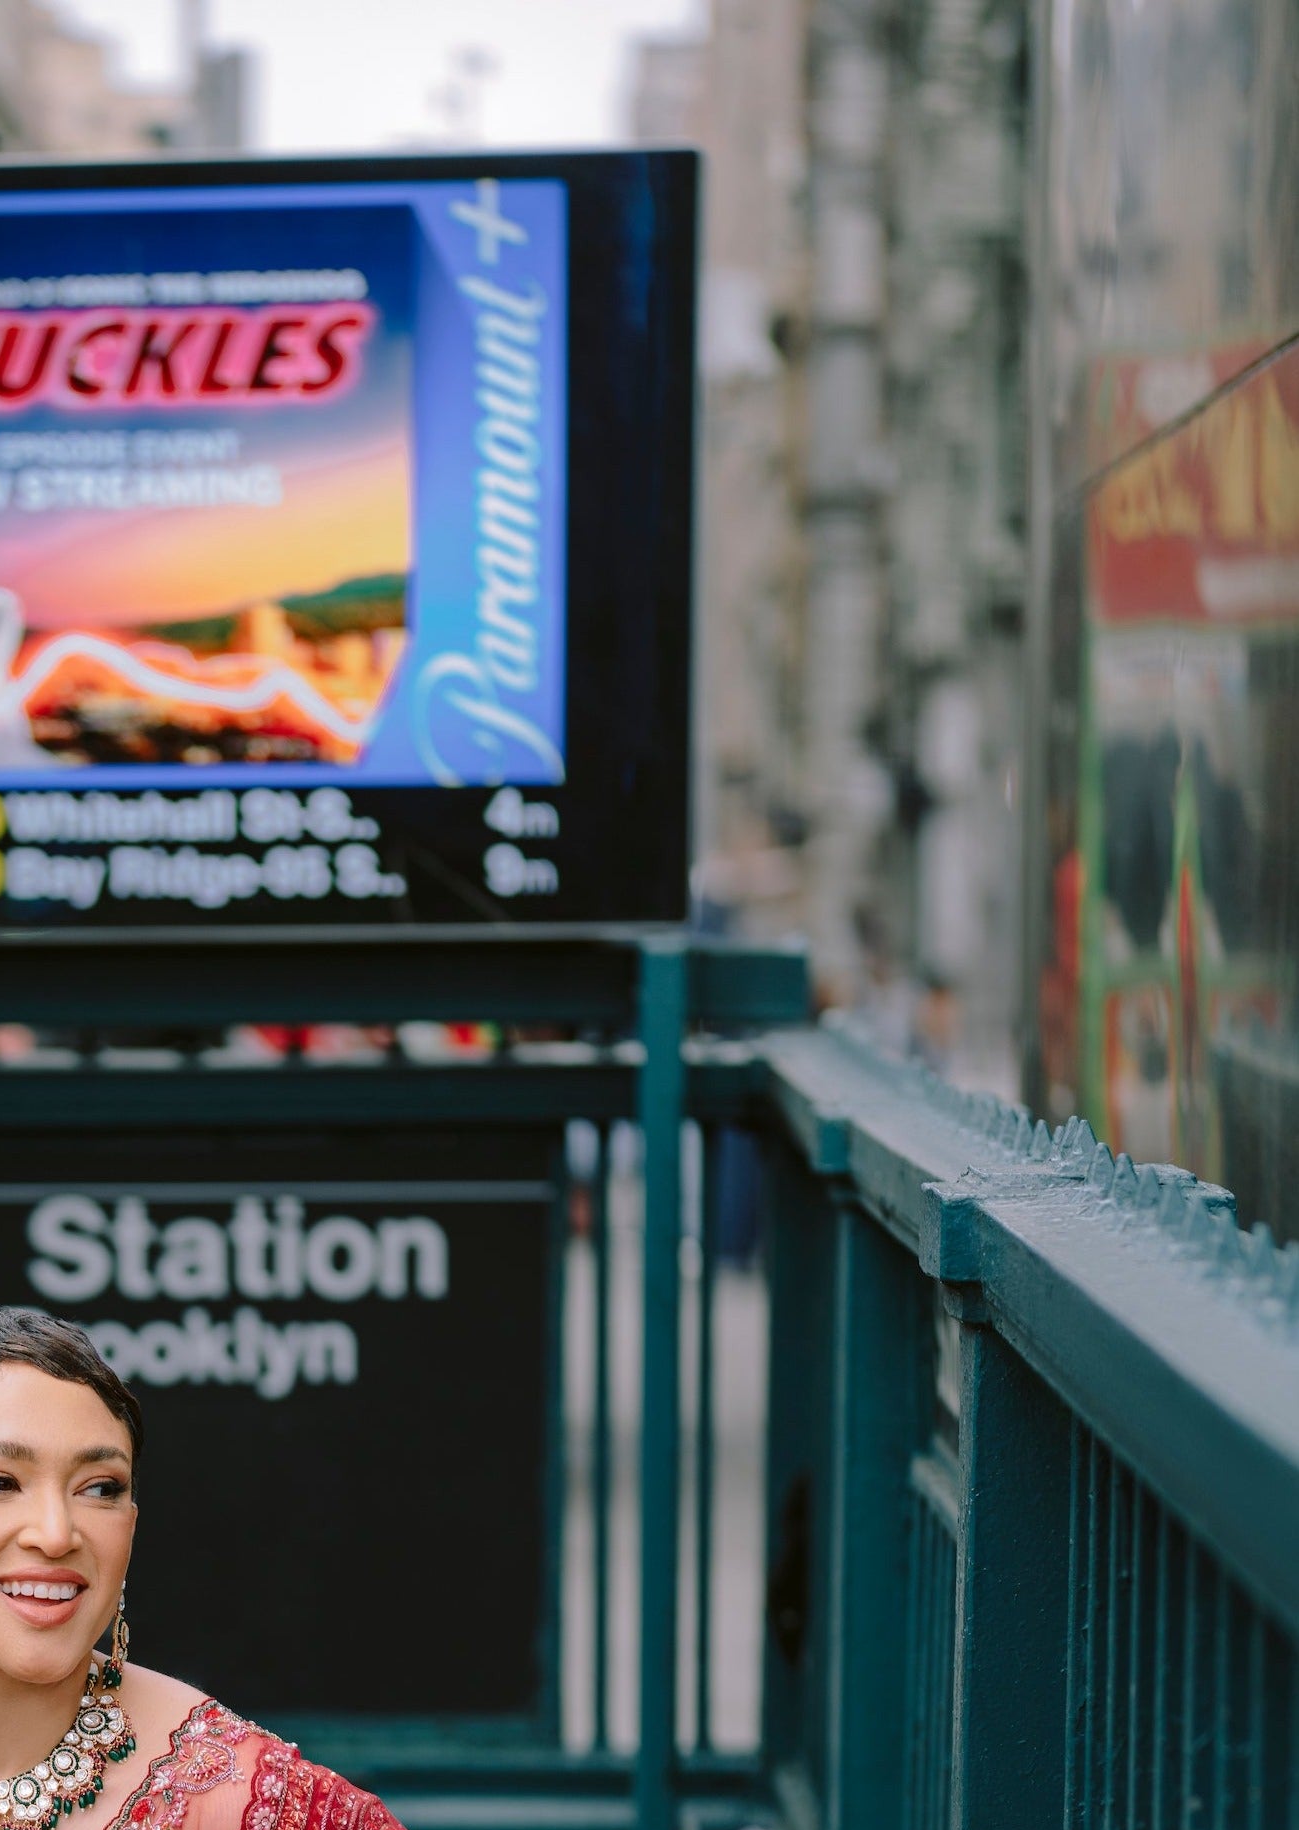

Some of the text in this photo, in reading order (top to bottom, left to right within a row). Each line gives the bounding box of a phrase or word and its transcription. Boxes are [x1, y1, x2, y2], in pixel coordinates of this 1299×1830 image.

[12, 463, 282, 510] STREAMING
[26, 1194, 449, 1302] Station
[4, 1306, 359, 1401] ooklyn
